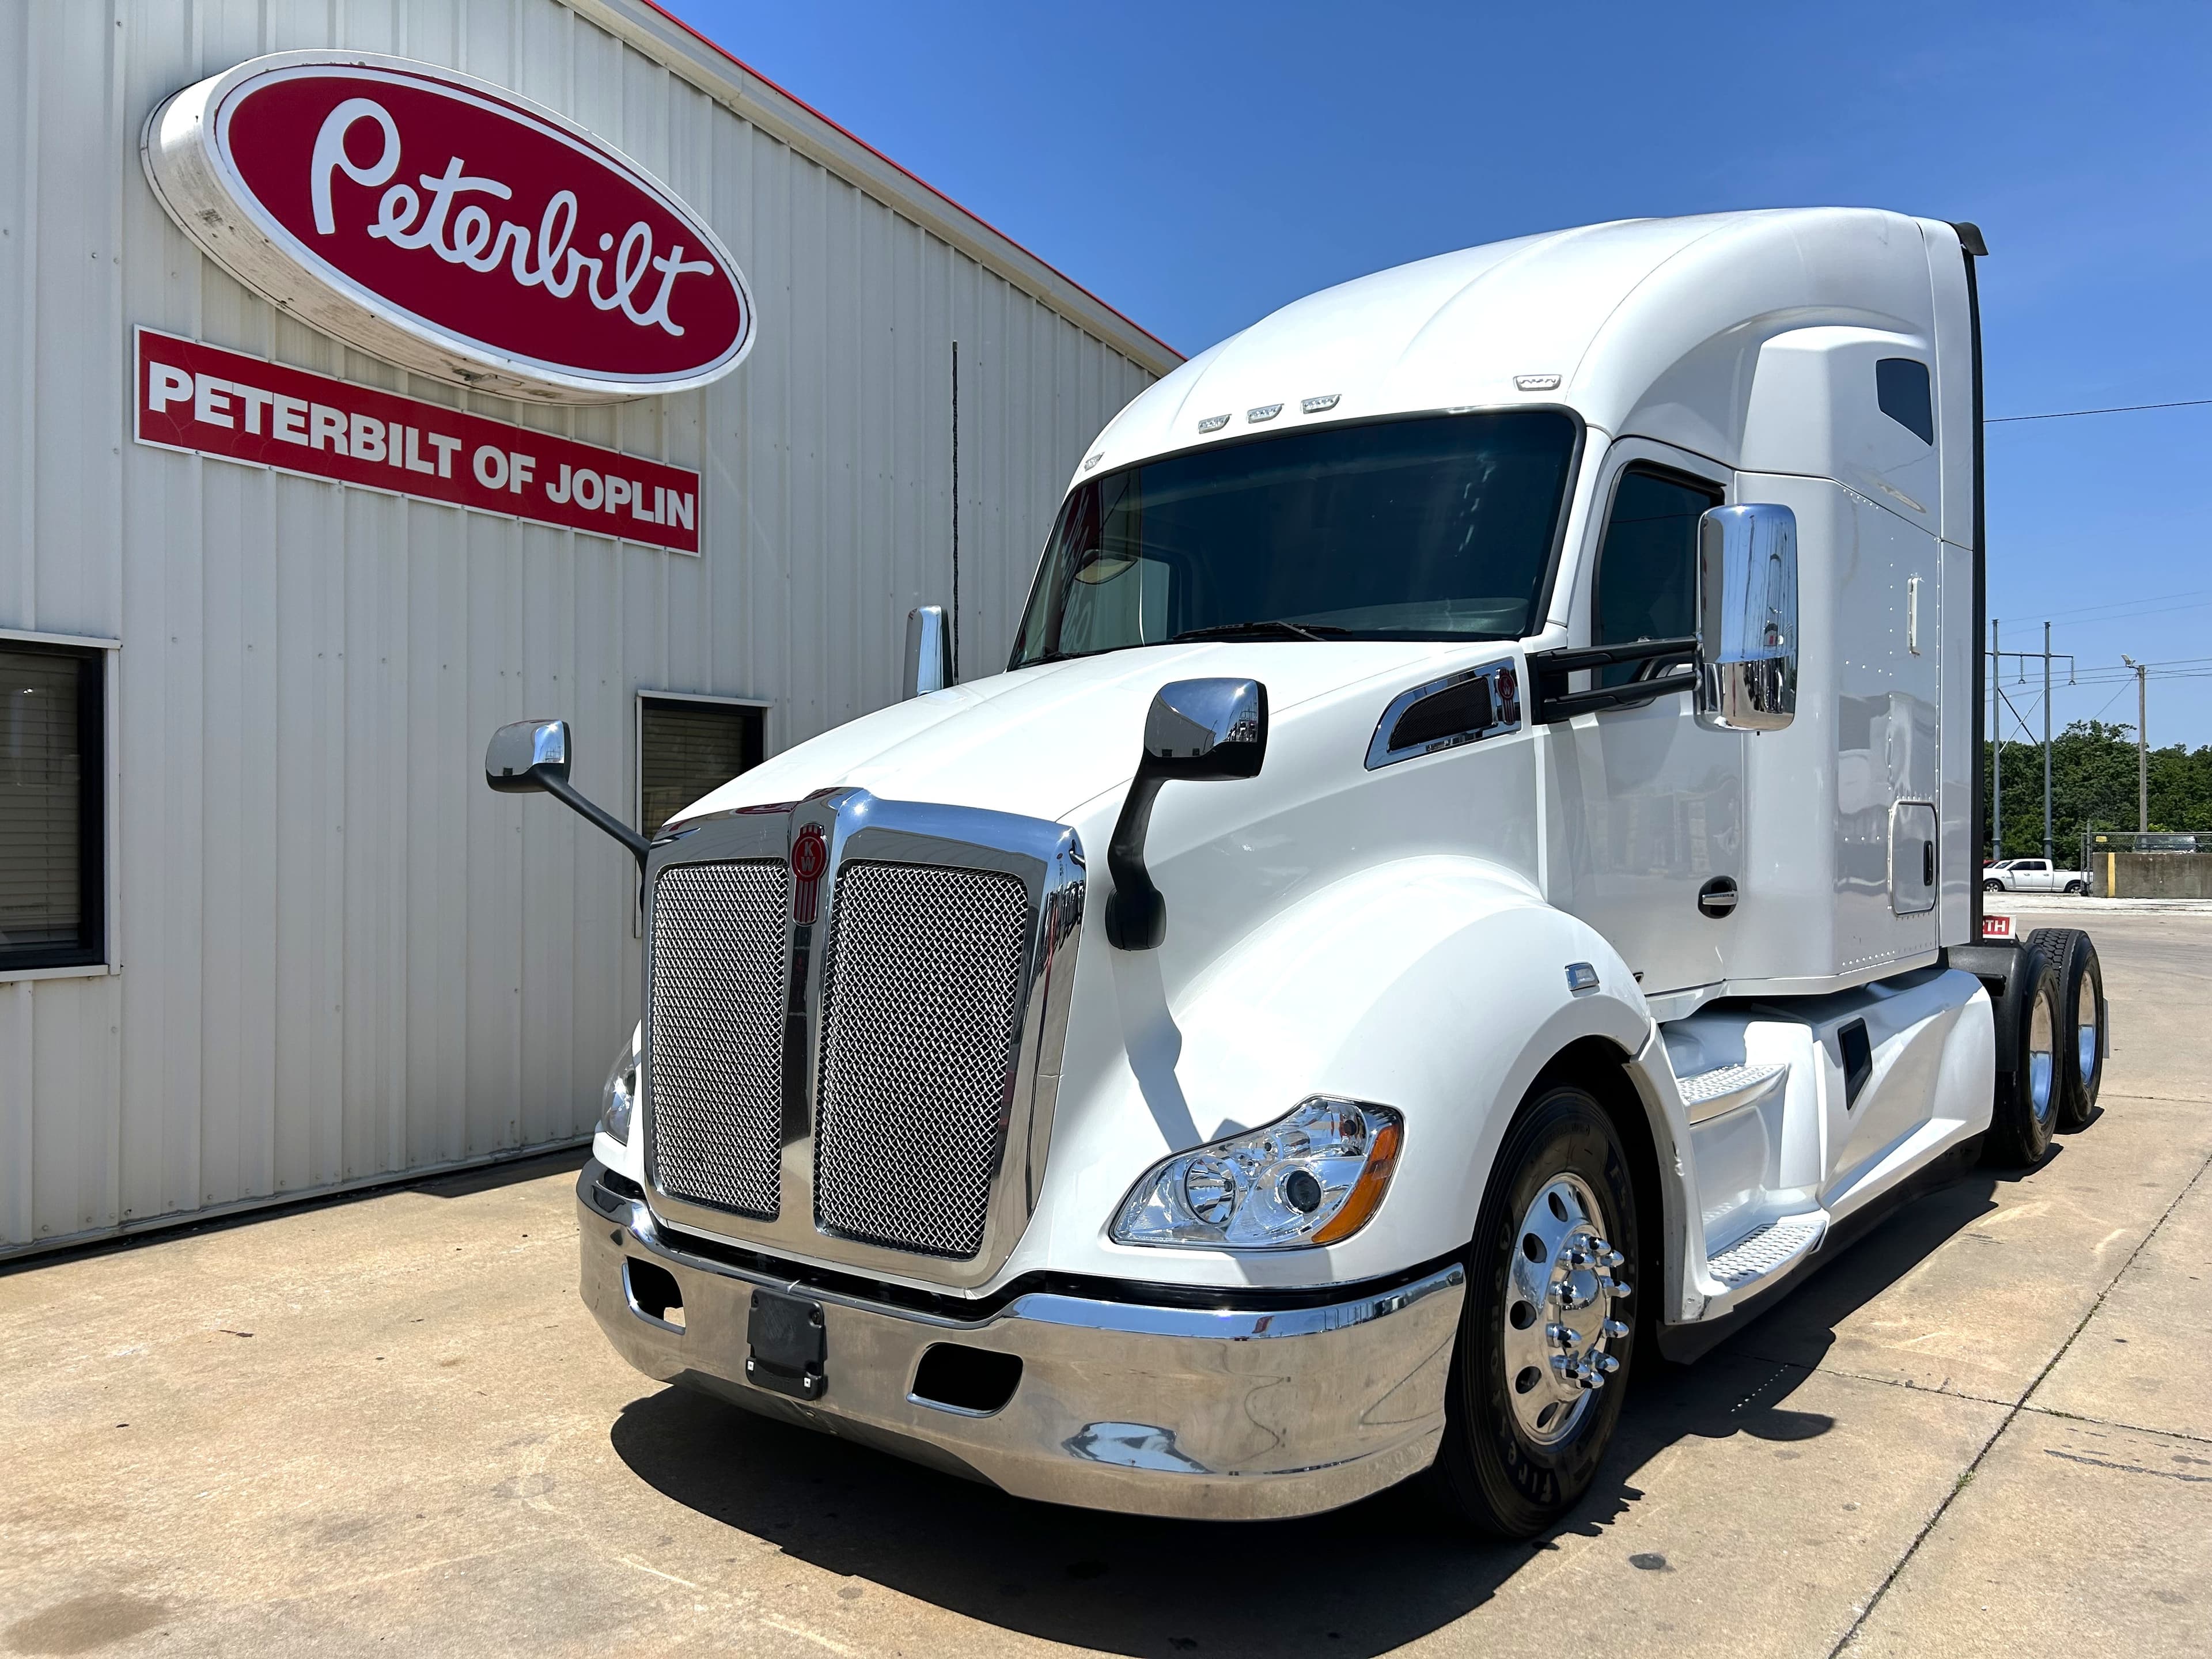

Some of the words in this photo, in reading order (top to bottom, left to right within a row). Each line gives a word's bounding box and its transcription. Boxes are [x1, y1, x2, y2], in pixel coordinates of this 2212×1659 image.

[310, 97, 714, 336] Peterbilt
[149, 361, 462, 479] PETERBILT
[473, 445, 536, 494] OF
[546, 464, 694, 531] JOPLIN
[1983, 919, 2006, 932] TH
